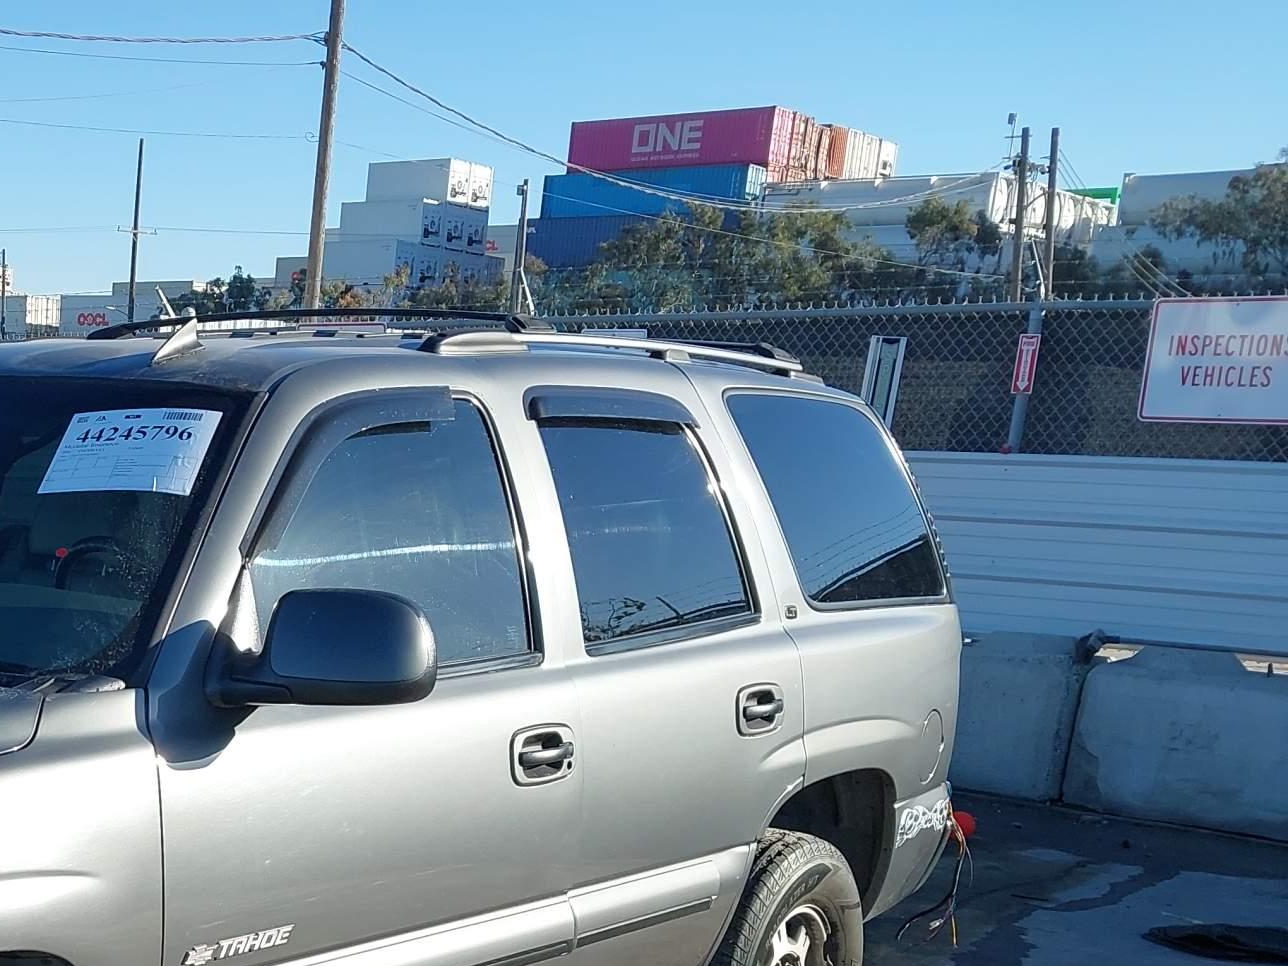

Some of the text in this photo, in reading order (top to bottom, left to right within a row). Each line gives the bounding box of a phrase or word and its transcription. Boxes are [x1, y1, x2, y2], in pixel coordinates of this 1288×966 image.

[631, 120, 704, 153] ONE
[1180, 365, 1273, 388] VEHICLES
[76, 425, 195, 443] 44245796
[218, 923, 296, 959] TAHOE
